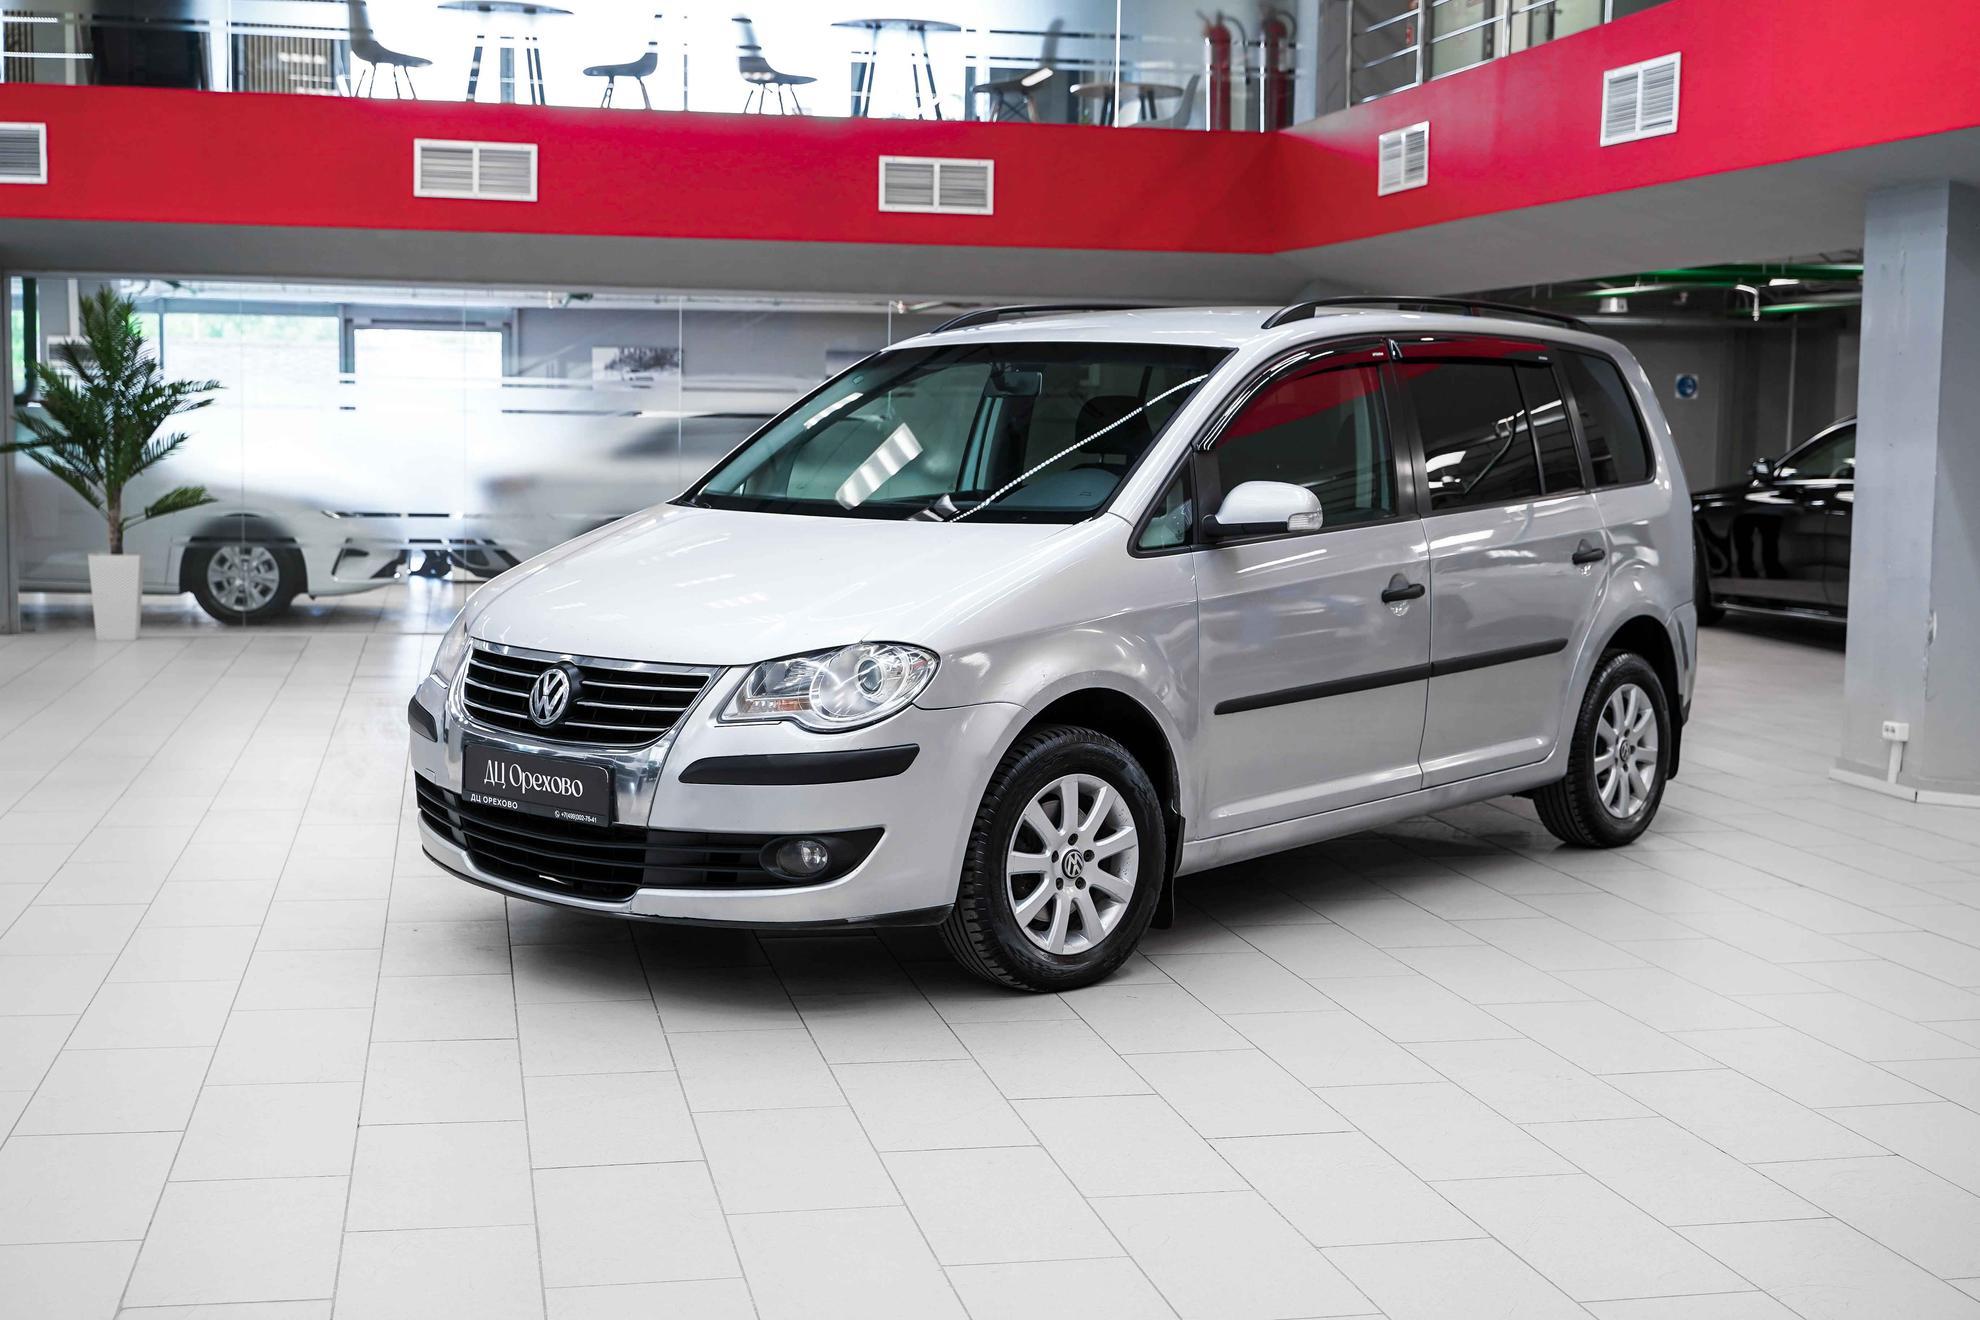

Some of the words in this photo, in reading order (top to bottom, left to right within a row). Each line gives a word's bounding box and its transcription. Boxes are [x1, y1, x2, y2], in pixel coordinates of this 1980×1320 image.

[484, 759, 506, 789] ДЦ
[509, 763, 583, 798] Орехово
[470, 793, 481, 804] ДЦ
[482, 795, 518, 809] ОРЕХОВО
